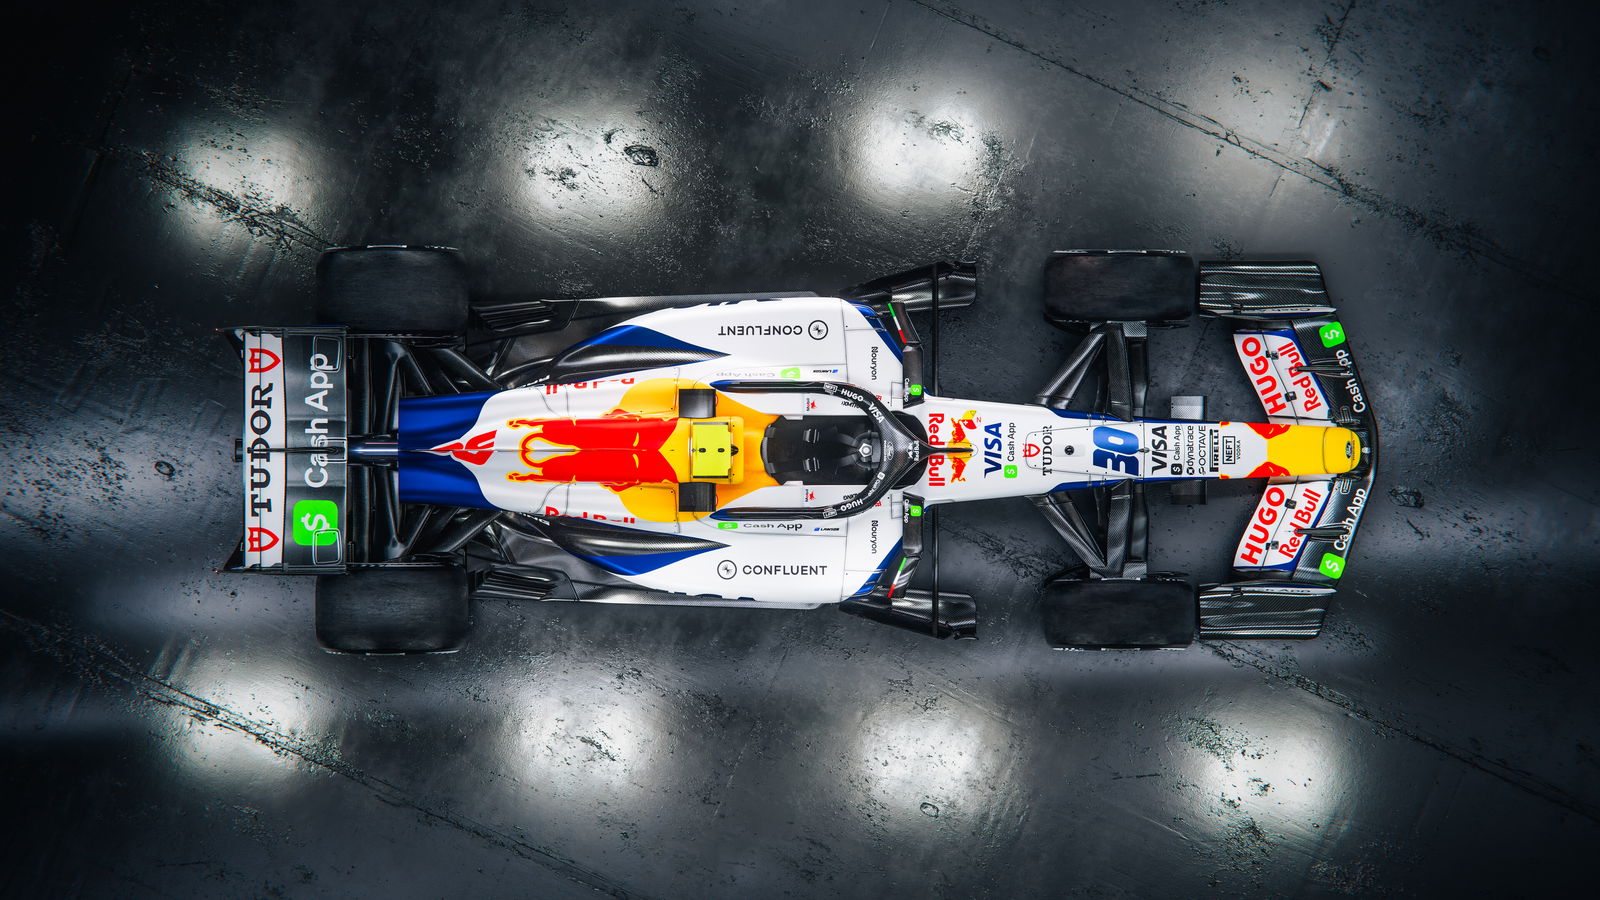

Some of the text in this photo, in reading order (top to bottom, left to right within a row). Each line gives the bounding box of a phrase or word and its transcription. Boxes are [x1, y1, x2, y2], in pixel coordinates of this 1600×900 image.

[718, 325, 803, 336] CONFLUENT
[305, 353, 334, 412] App
[840, 388, 864, 402] HUGO
[1241, 337, 1287, 414] HUGO
[1277, 342, 1321, 412] Red Bull
[1345, 378, 1366, 413] Cash
[868, 402, 885, 423] VISA
[1007, 422, 1016, 439] App
[1173, 425, 1182, 442] App
[250, 383, 273, 517] TUDOR
[305, 418, 329, 488] Cash
[928, 413, 945, 486] Red Bull
[984, 422, 1002, 478] VISA
[1007, 440, 1015, 462] Cash
[1042, 425, 1053, 476] TUDOR
[1093, 426, 1139, 477] 30
[1151, 425, 1168, 475] VISA
[1186, 425, 1195, 467] dynatrace
[1209, 429, 1219, 472] PIRELLI
[1225, 439, 1233, 461] NEFT
[840, 499, 864, 511] HUGO
[1278, 488, 1322, 558] Red Bull
[1346, 488, 1367, 517] App
[777, 523, 803, 531] App
[1240, 487, 1285, 565] HUGO
[742, 565, 828, 576] CONFLUENT
